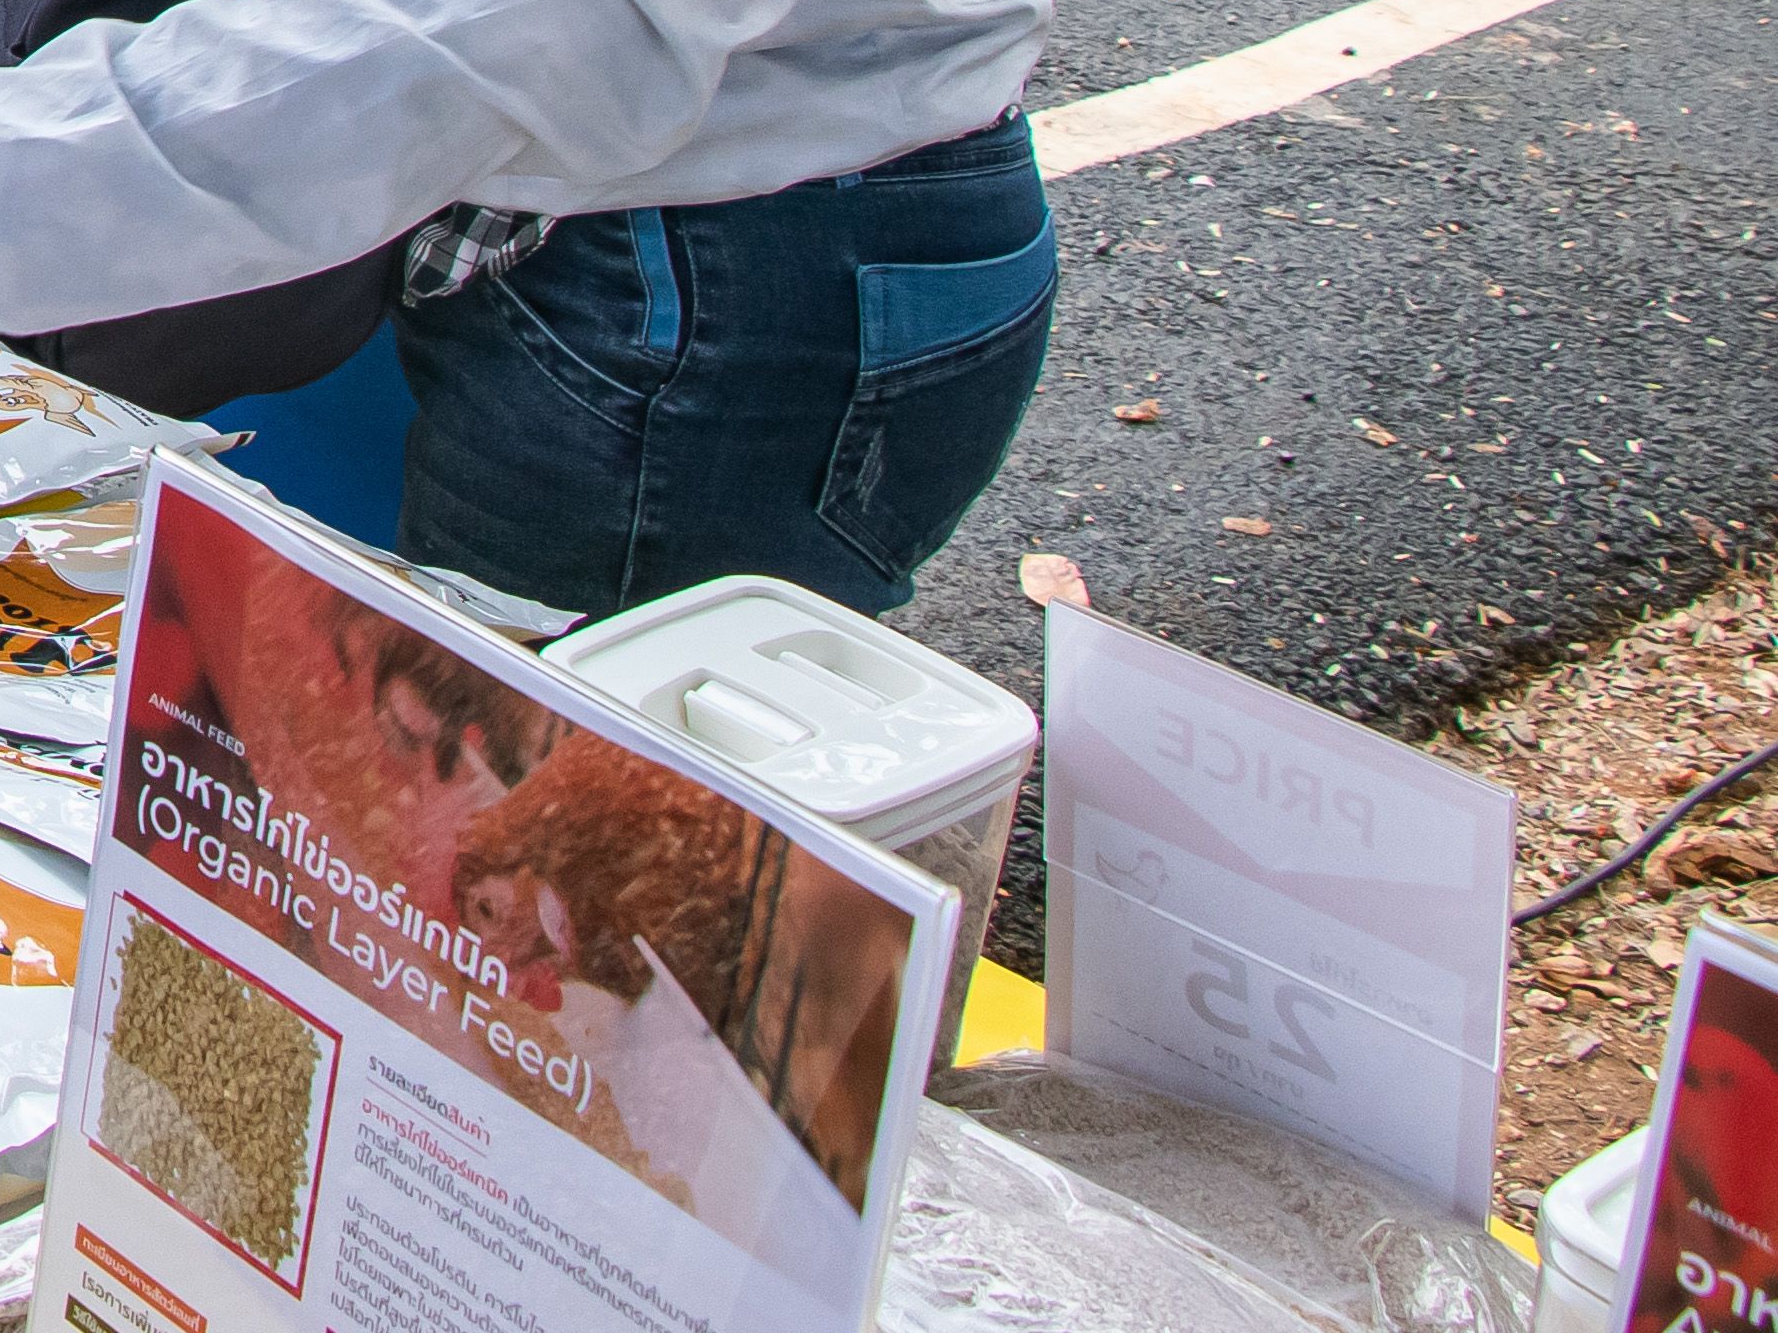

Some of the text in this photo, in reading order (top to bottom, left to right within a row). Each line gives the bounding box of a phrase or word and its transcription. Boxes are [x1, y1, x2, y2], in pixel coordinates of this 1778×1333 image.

[148, 692, 246, 757] ANIMAL FEED
[138, 741, 514, 995] อาหารไก่ไข่ออร์แกนิค
[134, 784, 318, 928] (Organic
[325, 906, 449, 1013] Layer
[458, 991, 595, 1113] Feed)
[361, 1097, 509, 1205] อาหารไก่ไข่ออร์แกนิค
[368, 1055, 493, 1145] รายละเอียดสินค้า
